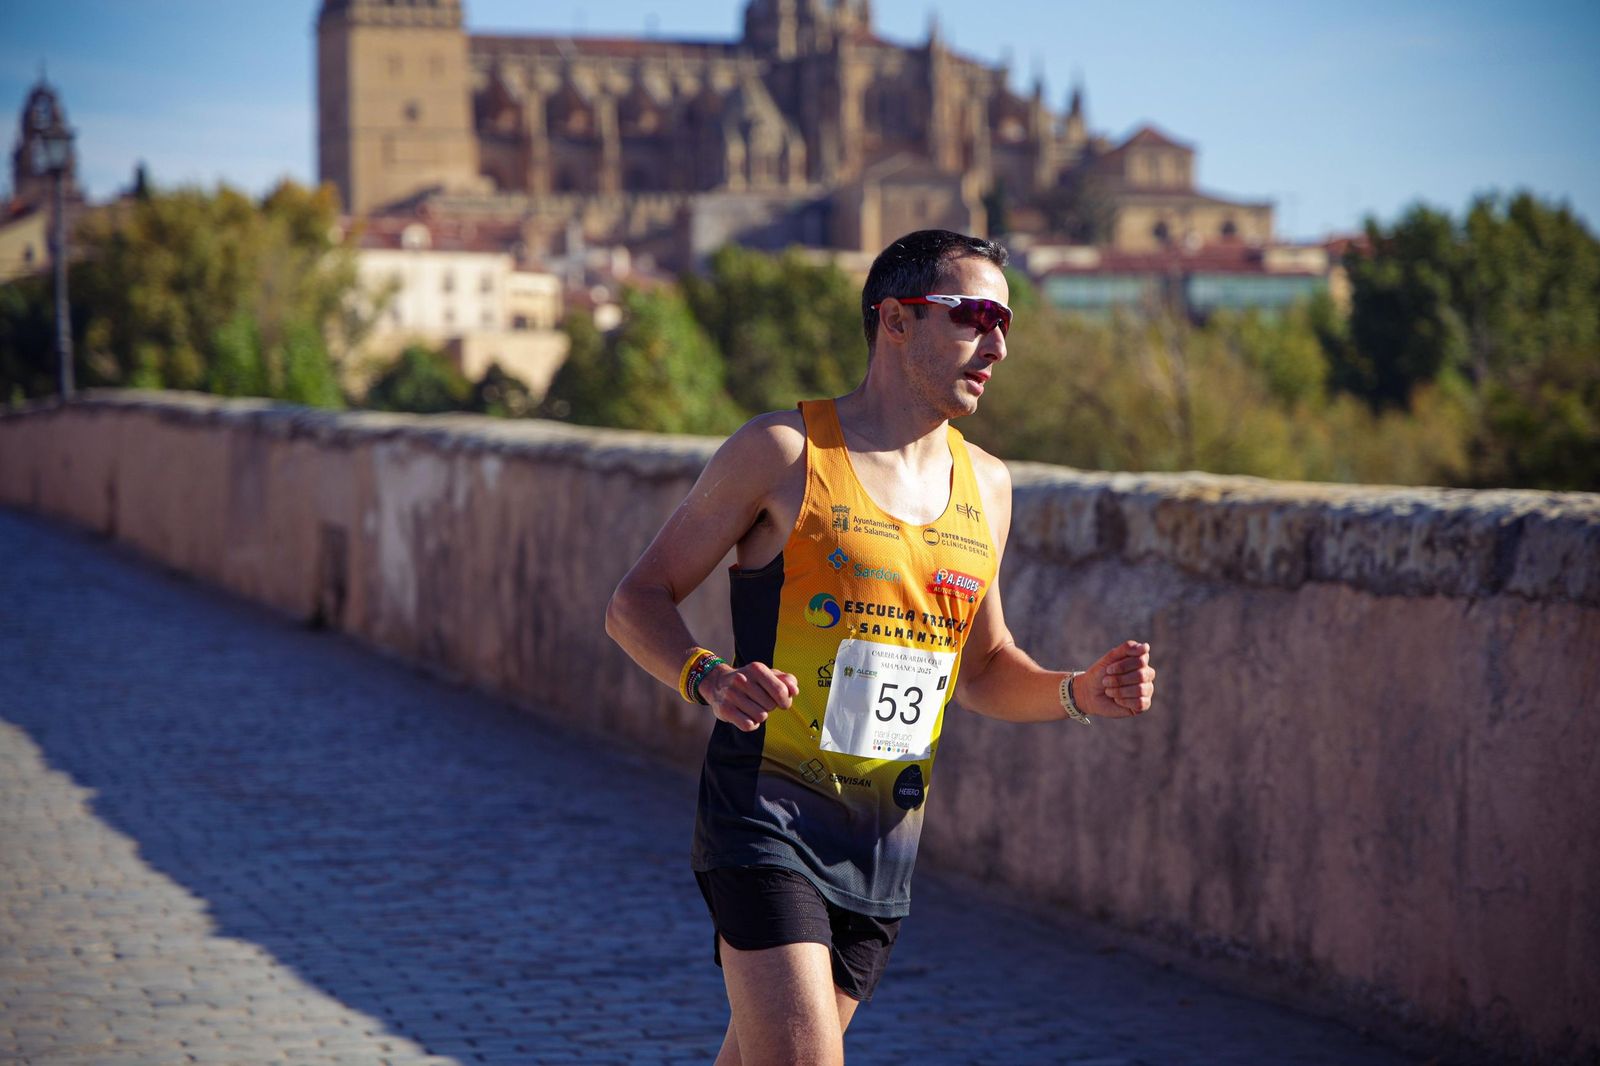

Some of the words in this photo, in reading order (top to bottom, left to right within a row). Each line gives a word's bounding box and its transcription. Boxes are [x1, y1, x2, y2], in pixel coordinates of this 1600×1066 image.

[956, 502, 980, 522] EKT
[853, 516, 900, 531] Ayuntamiento
[853, 525, 862, 533] de
[864, 526, 900, 540] Salamanca
[968, 546, 989, 558] DENTAL
[853, 562, 901, 583] Sardón
[956, 575, 979, 592] ELICES
[844, 600, 916, 622] ESCUELA
[871, 650, 899, 660] CARRERA
[900, 654, 927, 663] GUARDIA
[881, 662, 916, 673] SALAMANCA
[917, 667, 932, 675] 2025
[875, 682, 923, 725] 53
[873, 739, 910, 748] EMPRESARIAL
